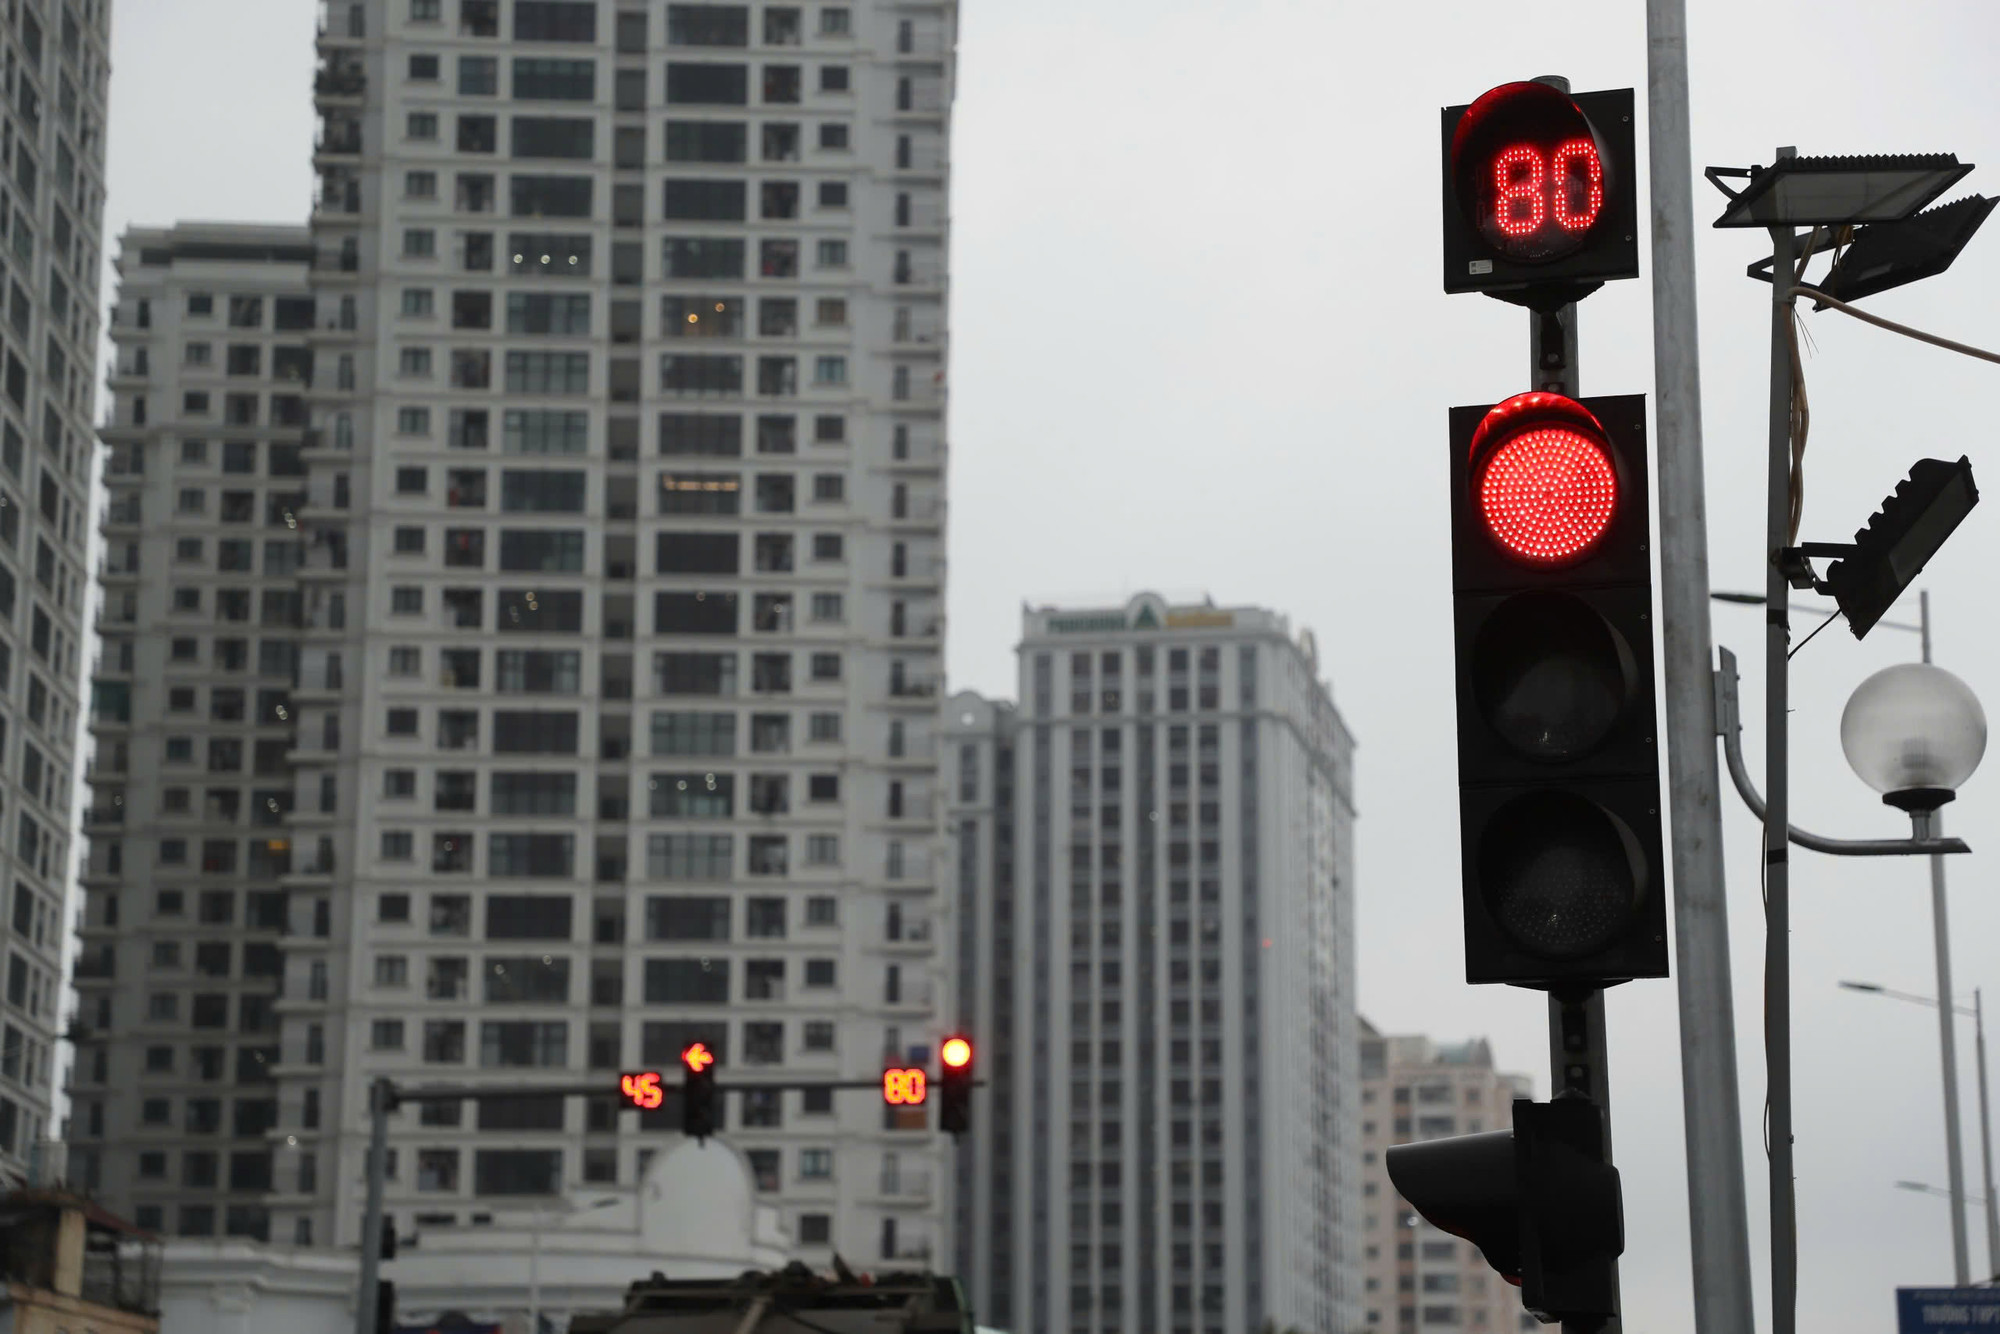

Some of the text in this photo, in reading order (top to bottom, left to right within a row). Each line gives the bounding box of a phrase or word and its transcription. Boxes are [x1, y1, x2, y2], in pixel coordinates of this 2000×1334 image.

[1495, 141, 1602, 235] 80
[621, 1072, 663, 1108] 45
[883, 1068, 926, 1105] 80
